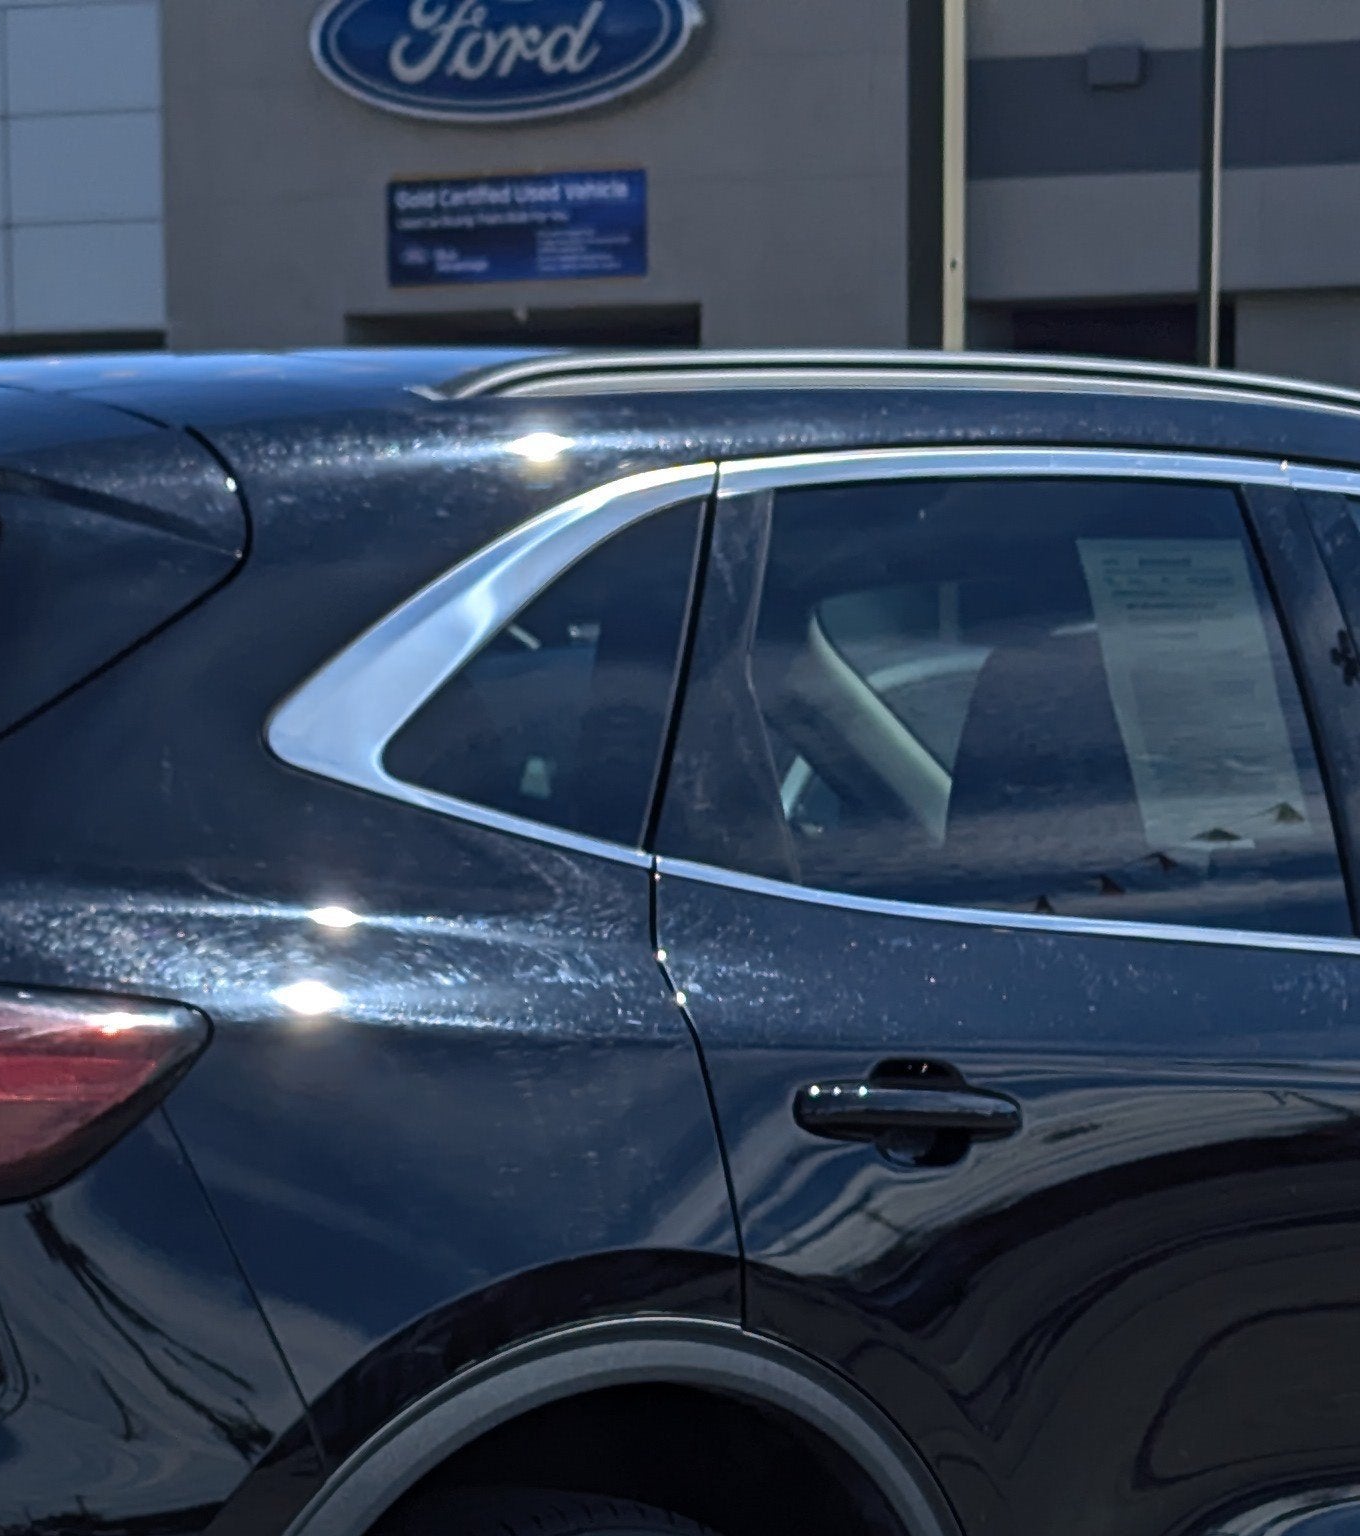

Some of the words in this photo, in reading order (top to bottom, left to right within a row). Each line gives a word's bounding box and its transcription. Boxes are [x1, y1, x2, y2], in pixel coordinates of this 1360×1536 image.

[388, 0, 603, 84] Ford
[439, 182, 511, 208] Certified
[512, 182, 561, 204] Used
[563, 178, 630, 201] Vehicle
